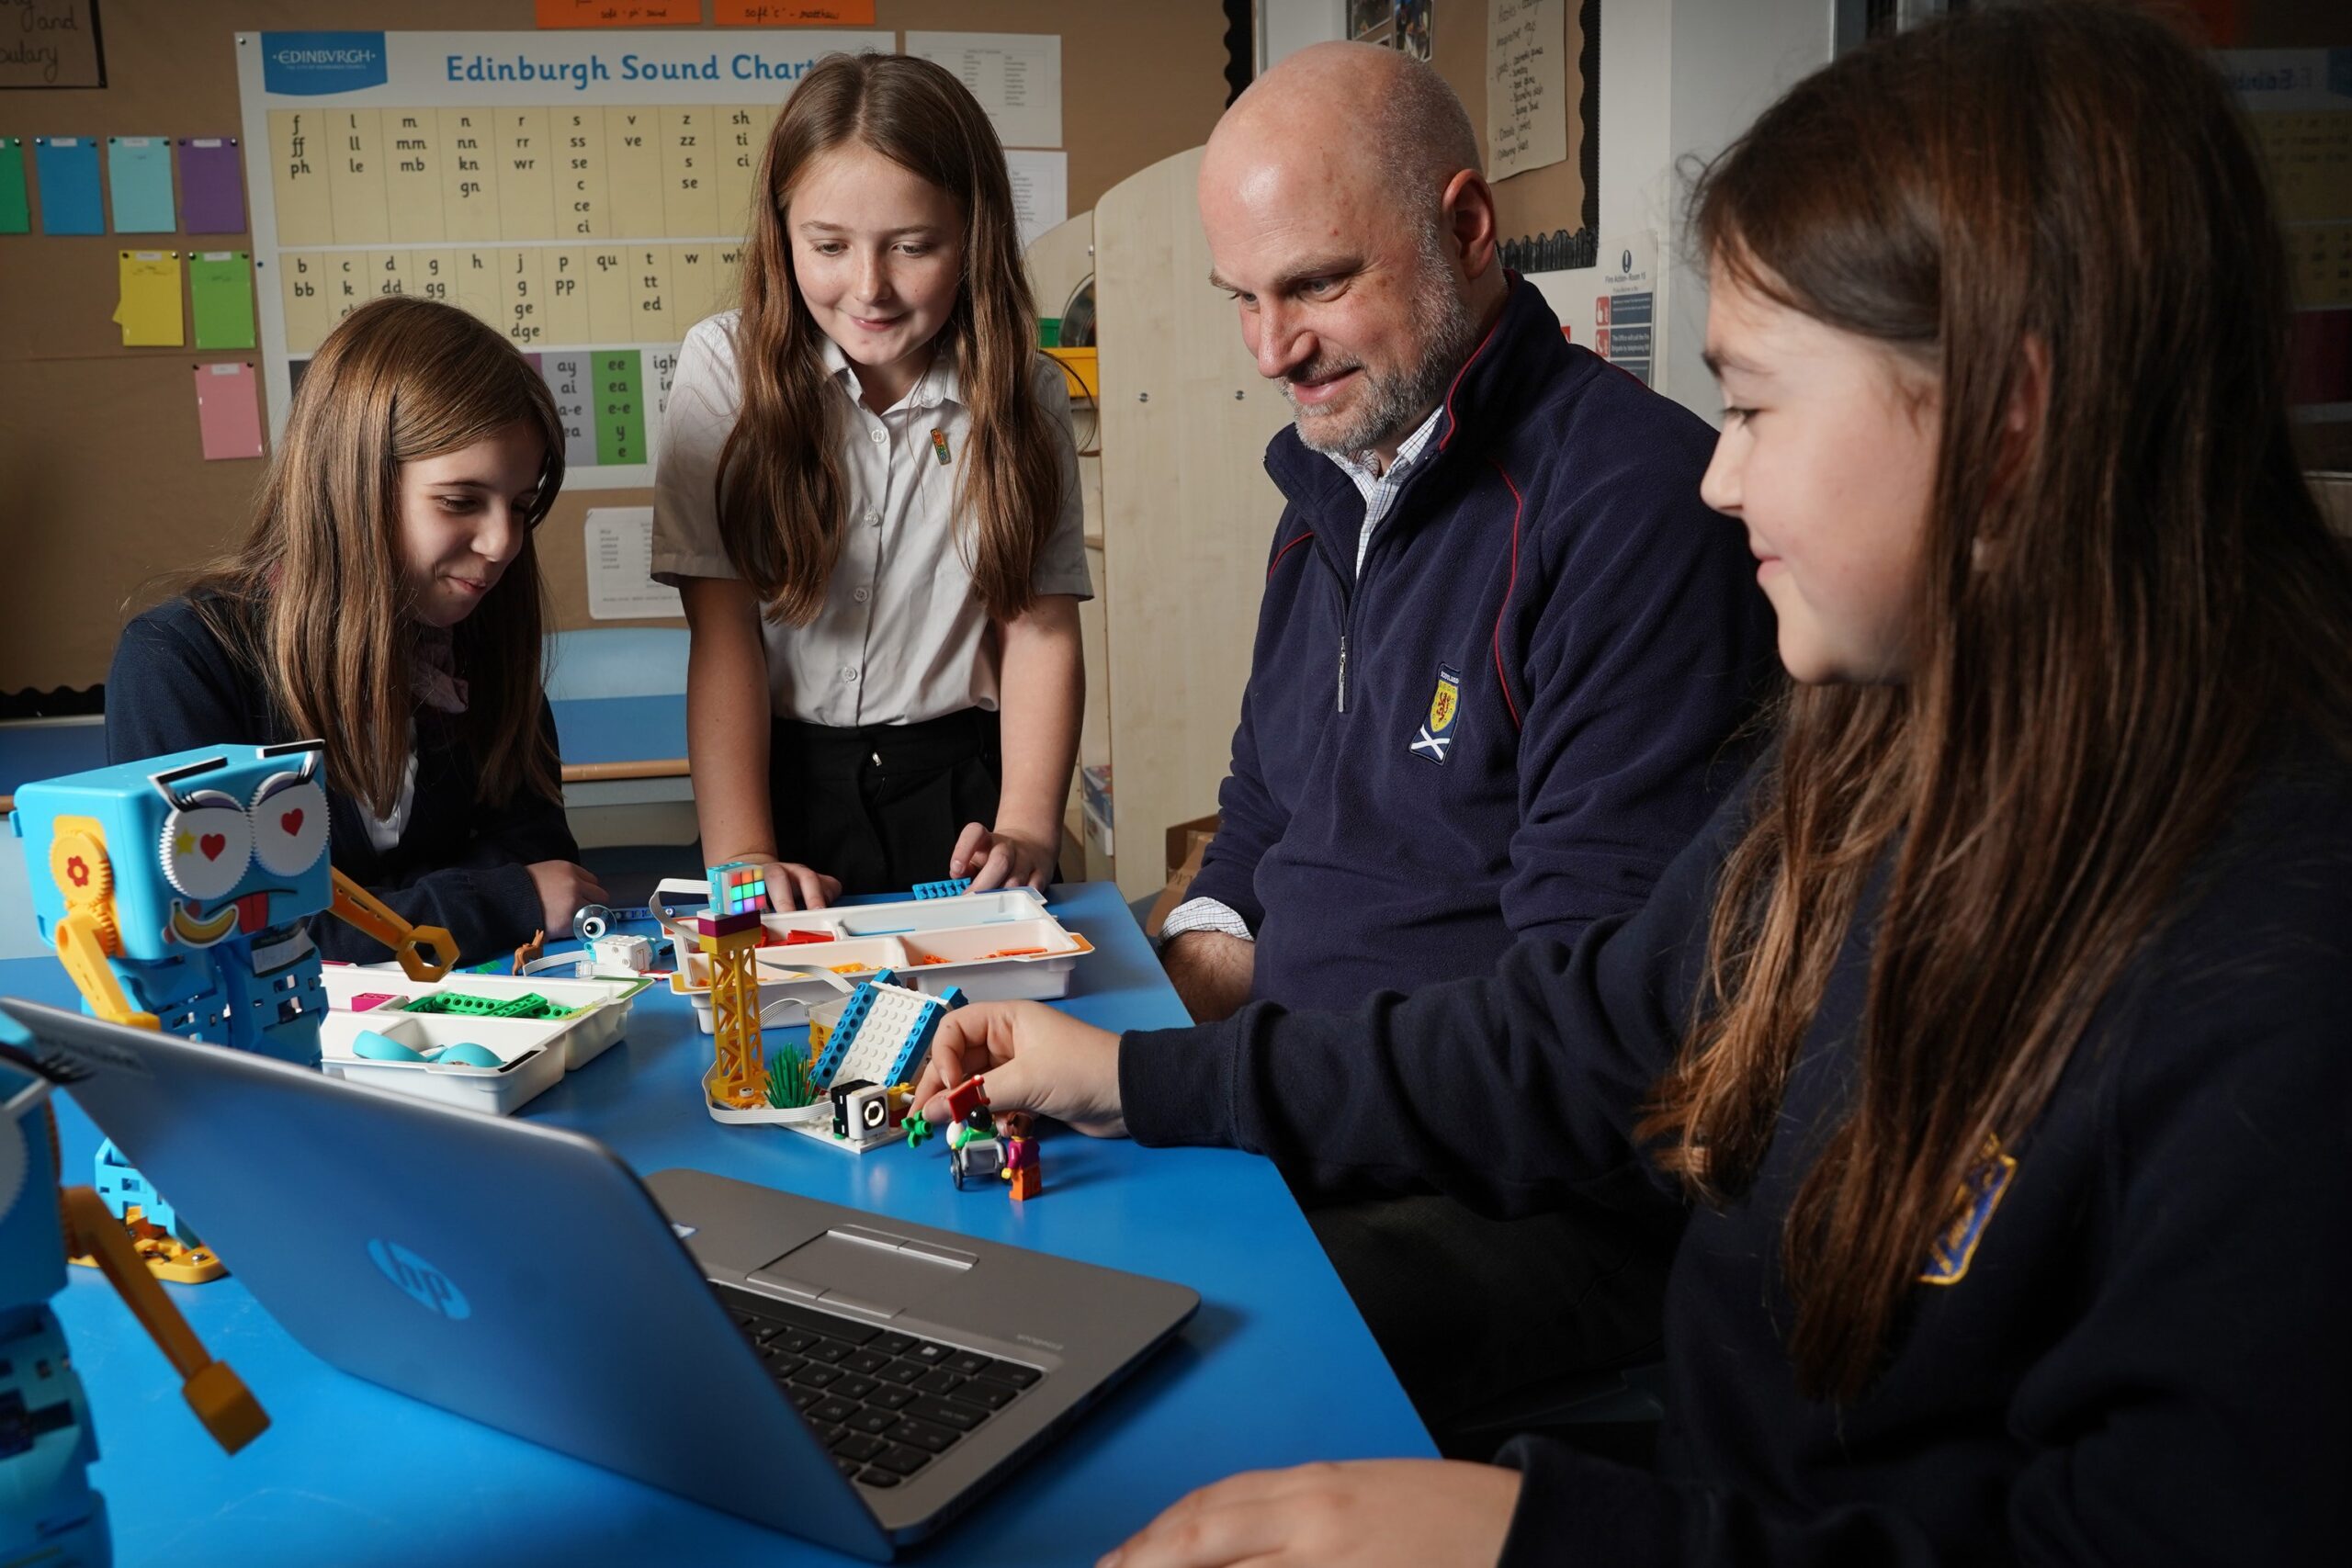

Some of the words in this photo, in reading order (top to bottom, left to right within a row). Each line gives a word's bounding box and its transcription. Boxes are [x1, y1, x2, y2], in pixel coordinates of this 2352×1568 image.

[37, 4, 79, 31] and
[447, 54, 610, 90] Edinburgh
[621, 54, 720, 80] Sound
[731, 54, 814, 80] Chart
[292, 114, 300, 137] f
[350, 113, 356, 130] l
[401, 118, 418, 129] m
[460, 117, 471, 128] n
[518, 116, 526, 127] r
[572, 115, 581, 127] s
[627, 115, 637, 126] v
[683, 115, 691, 125] z
[732, 109, 751, 125] sh
[291, 136, 305, 159] ff
[349, 135, 361, 152] ll
[396, 140, 427, 151] mm
[457, 139, 478, 150] nn
[516, 138, 530, 148] rr
[570, 137, 586, 148] ss
[624, 136, 642, 147] ve
[680, 136, 695, 147] zz
[735, 131, 749, 146] ti
[290, 158, 311, 180] ph
[349, 157, 364, 174] le
[400, 156, 425, 172] mb
[458, 155, 480, 171] kn
[514, 159, 535, 170] wr
[571, 158, 588, 170] se
[684, 157, 693, 168] s
[736, 153, 751, 167] ci
[459, 182, 481, 198] gn
[577, 180, 585, 191] c
[682, 178, 698, 189] se
[573, 201, 591, 212] ce
[576, 219, 591, 233] ci
[297, 257, 308, 274] b
[342, 261, 351, 273] c
[385, 255, 396, 272] d
[428, 259, 439, 276] g
[471, 253, 483, 269] h
[516, 253, 524, 275] j
[559, 256, 569, 273] p
[596, 255, 618, 272] qu
[645, 253, 653, 265] t
[684, 254, 699, 265] w
[294, 281, 315, 298] bb
[343, 280, 355, 296] k
[380, 278, 403, 295] dd
[424, 281, 447, 299] gg
[517, 280, 527, 298] g
[555, 279, 575, 297] pp
[643, 276, 659, 288] tt
[514, 303, 534, 320] ge
[642, 295, 662, 311] ed
[510, 322, 540, 344] dge
[557, 361, 577, 378] ay
[607, 359, 626, 371] ee
[653, 355, 677, 375] igh
[560, 379, 577, 395] ai
[608, 381, 628, 393] ea
[559, 406, 582, 416] a-e
[607, 403, 631, 415] e-e
[616, 425, 626, 443] y
[617, 447, 627, 458] e
[368, 1238, 470, 1320] hp
